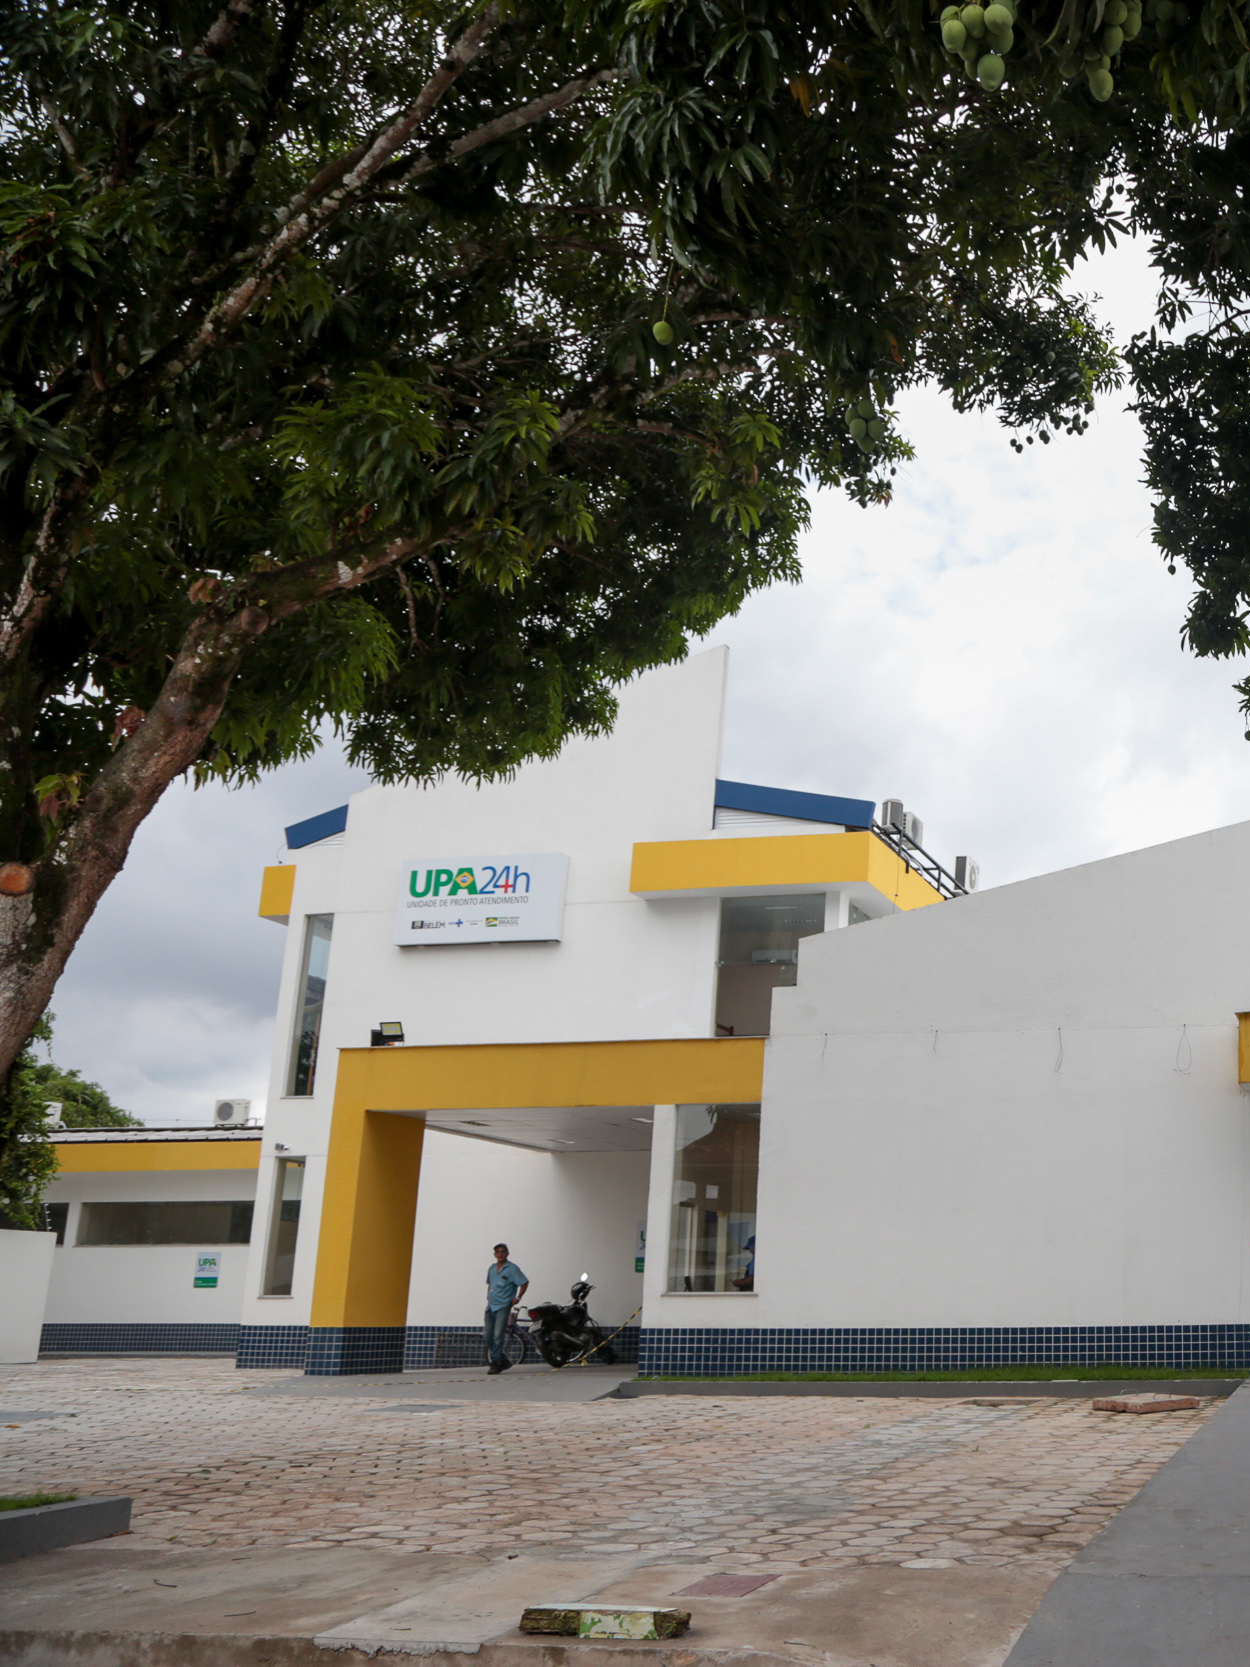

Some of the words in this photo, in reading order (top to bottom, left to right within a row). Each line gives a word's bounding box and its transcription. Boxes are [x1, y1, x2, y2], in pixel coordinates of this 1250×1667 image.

[406, 899, 437, 908] UNIDADE
[439, 899, 448, 907] DE
[450, 897, 477, 906] PRONTO
[479, 896, 529, 905] ATENDIMENTO
